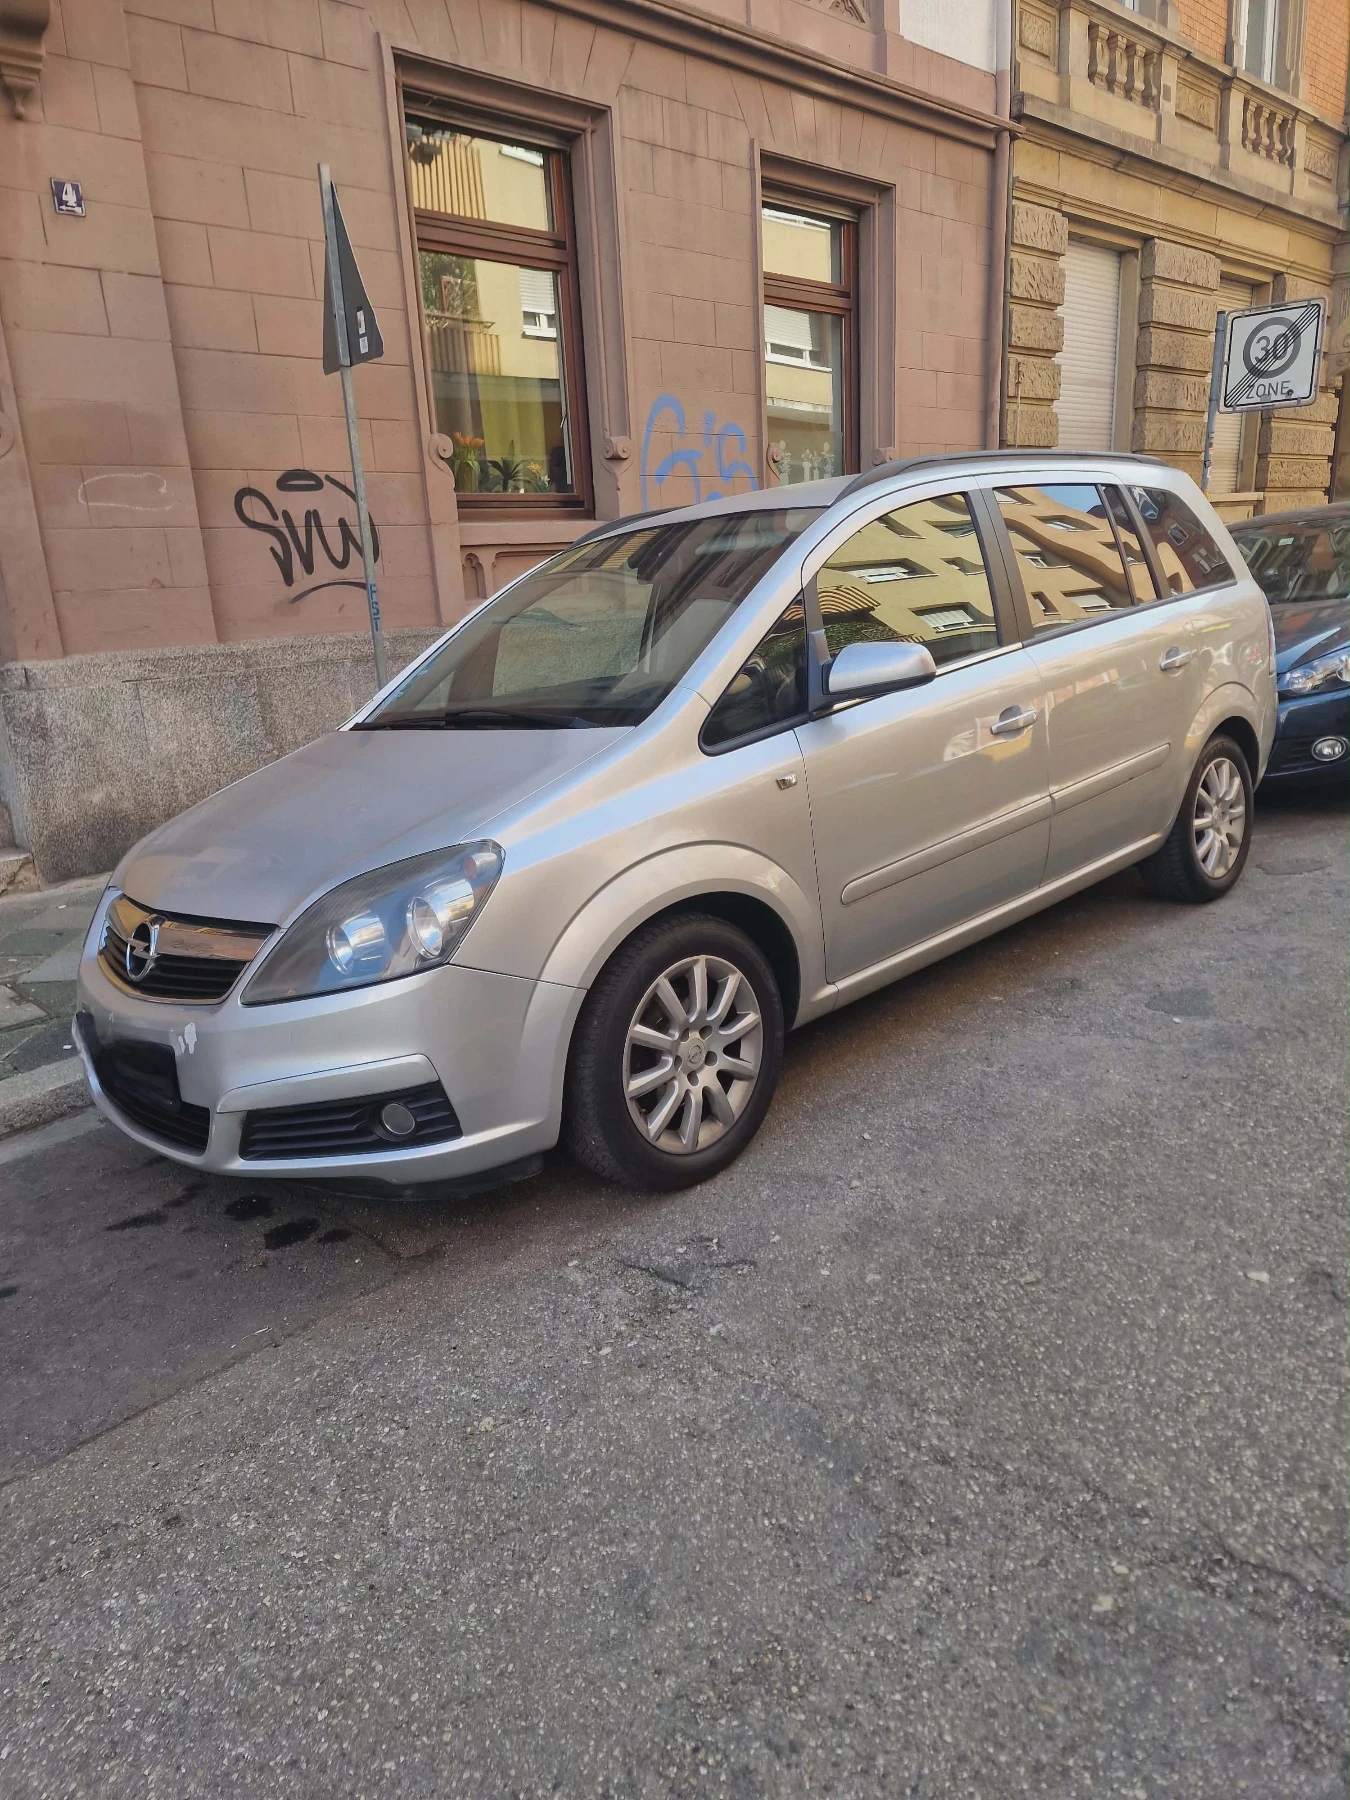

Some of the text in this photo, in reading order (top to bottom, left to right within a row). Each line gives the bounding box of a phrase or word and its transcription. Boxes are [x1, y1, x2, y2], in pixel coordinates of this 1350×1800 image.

[62, 183, 77, 206] 4
[1255, 332, 1288, 361] 30
[1245, 380, 1291, 399] ZONE
